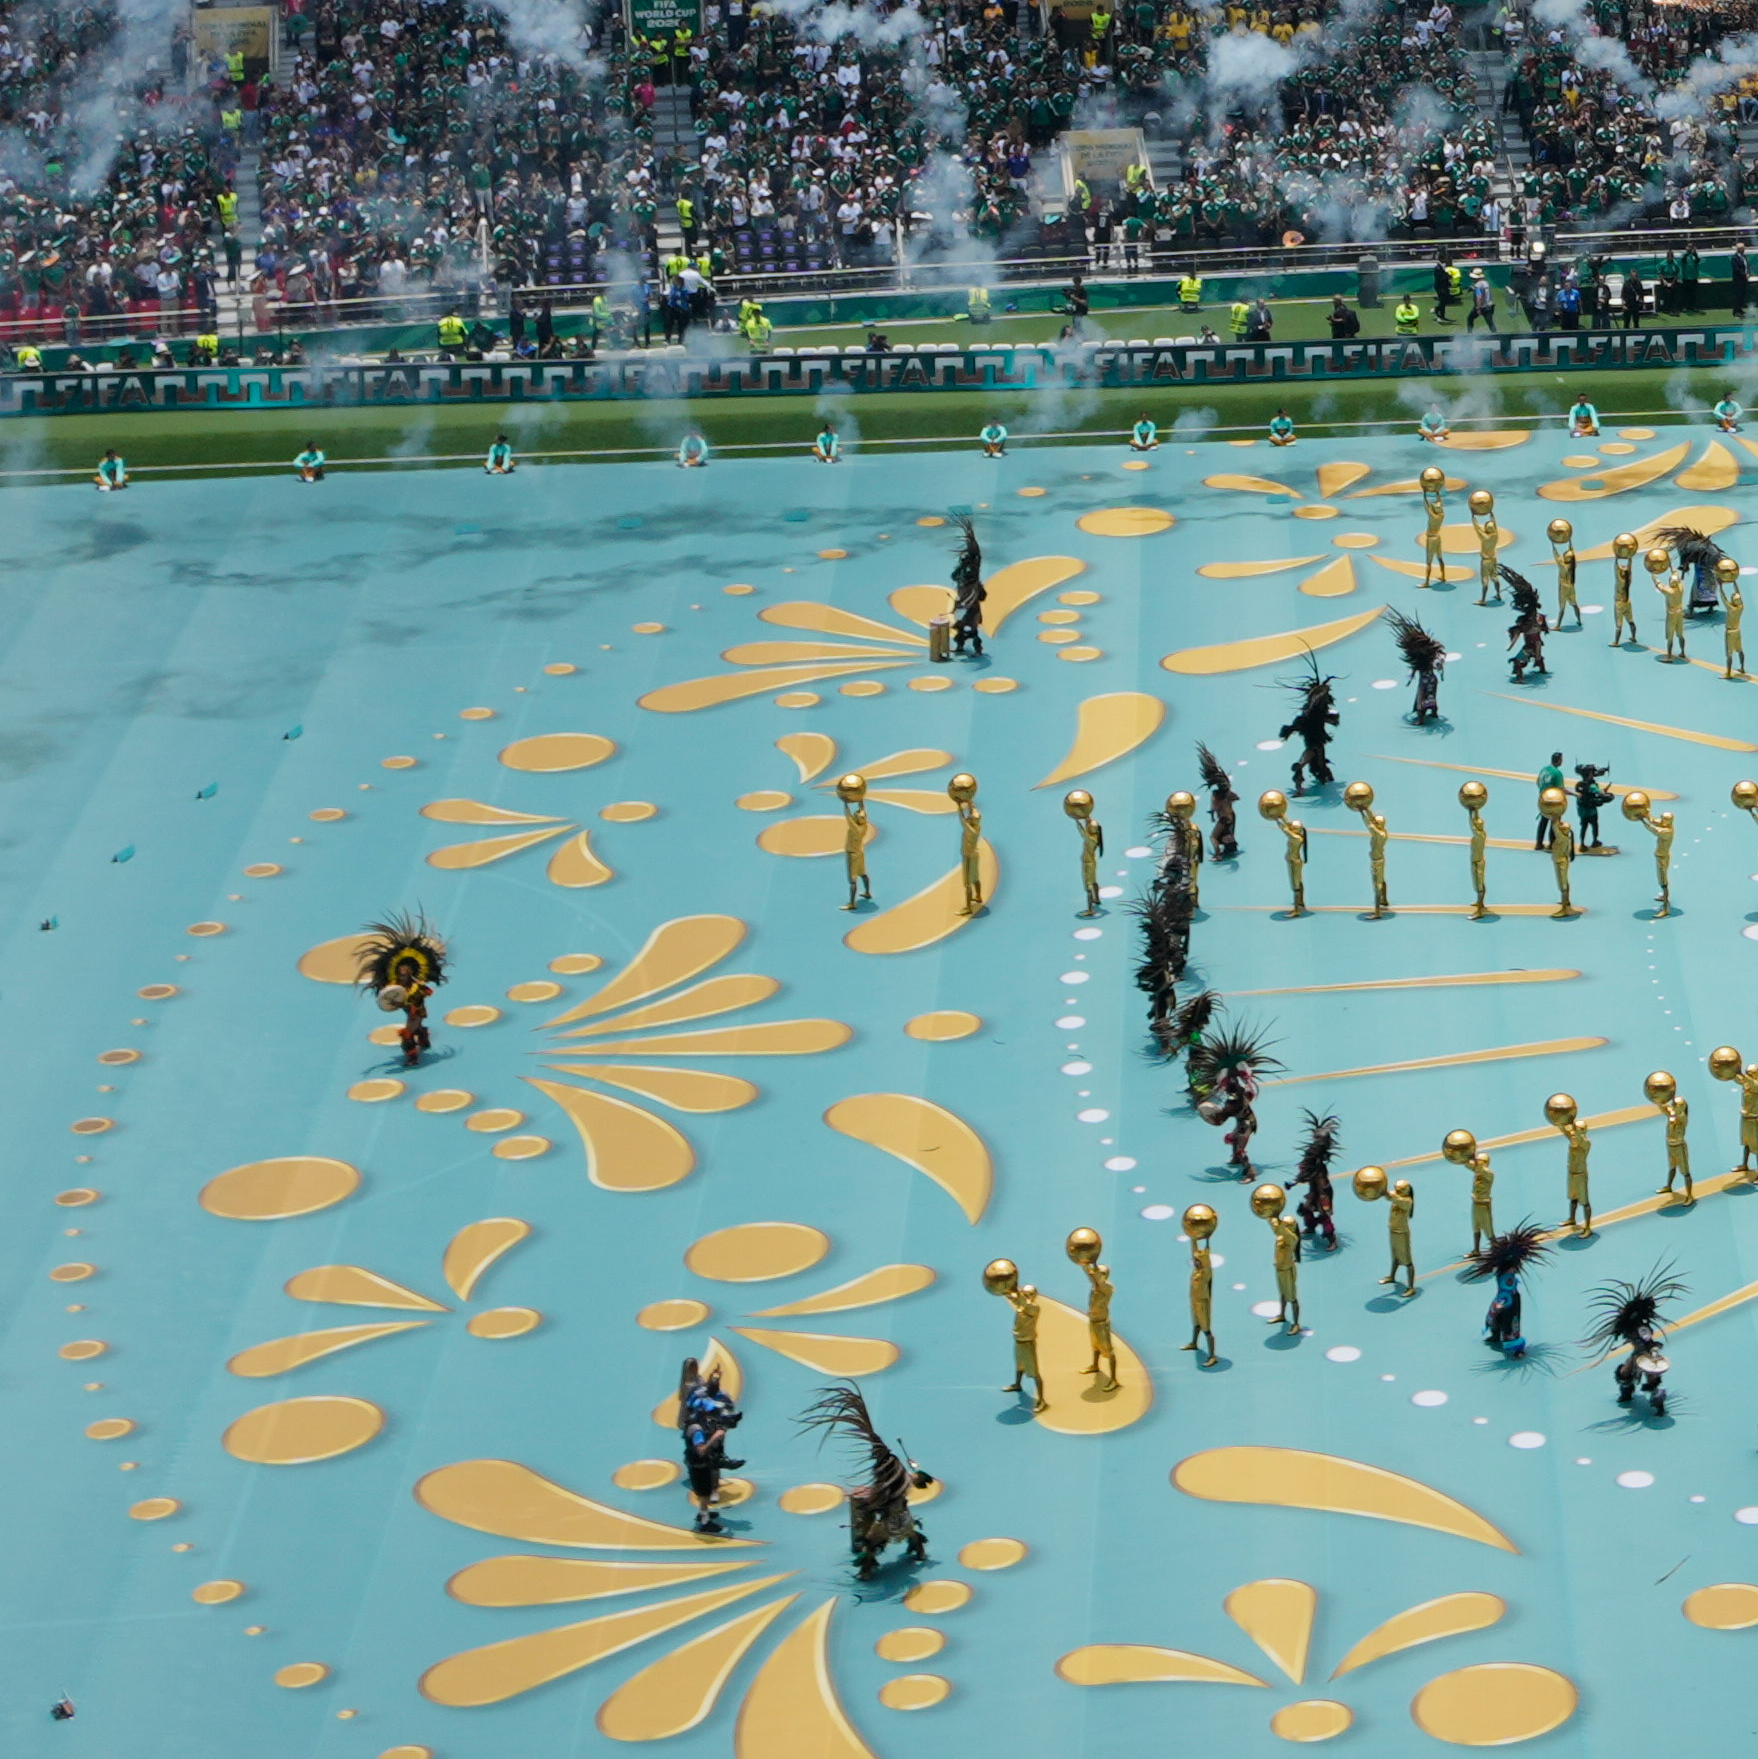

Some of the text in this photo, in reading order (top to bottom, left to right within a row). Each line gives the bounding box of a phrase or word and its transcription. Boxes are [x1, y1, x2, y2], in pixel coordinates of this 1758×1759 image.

[653, 0, 678, 9] FIFA
[634, 8, 697, 20] WORLD CUP
[57, 378, 149, 407] FIFA
[842, 358, 930, 389] FIFA
[1098, 351, 1184, 383] FIFA
[1343, 343, 1426, 374] FIFA
[1587, 334, 1676, 365] FIFA
